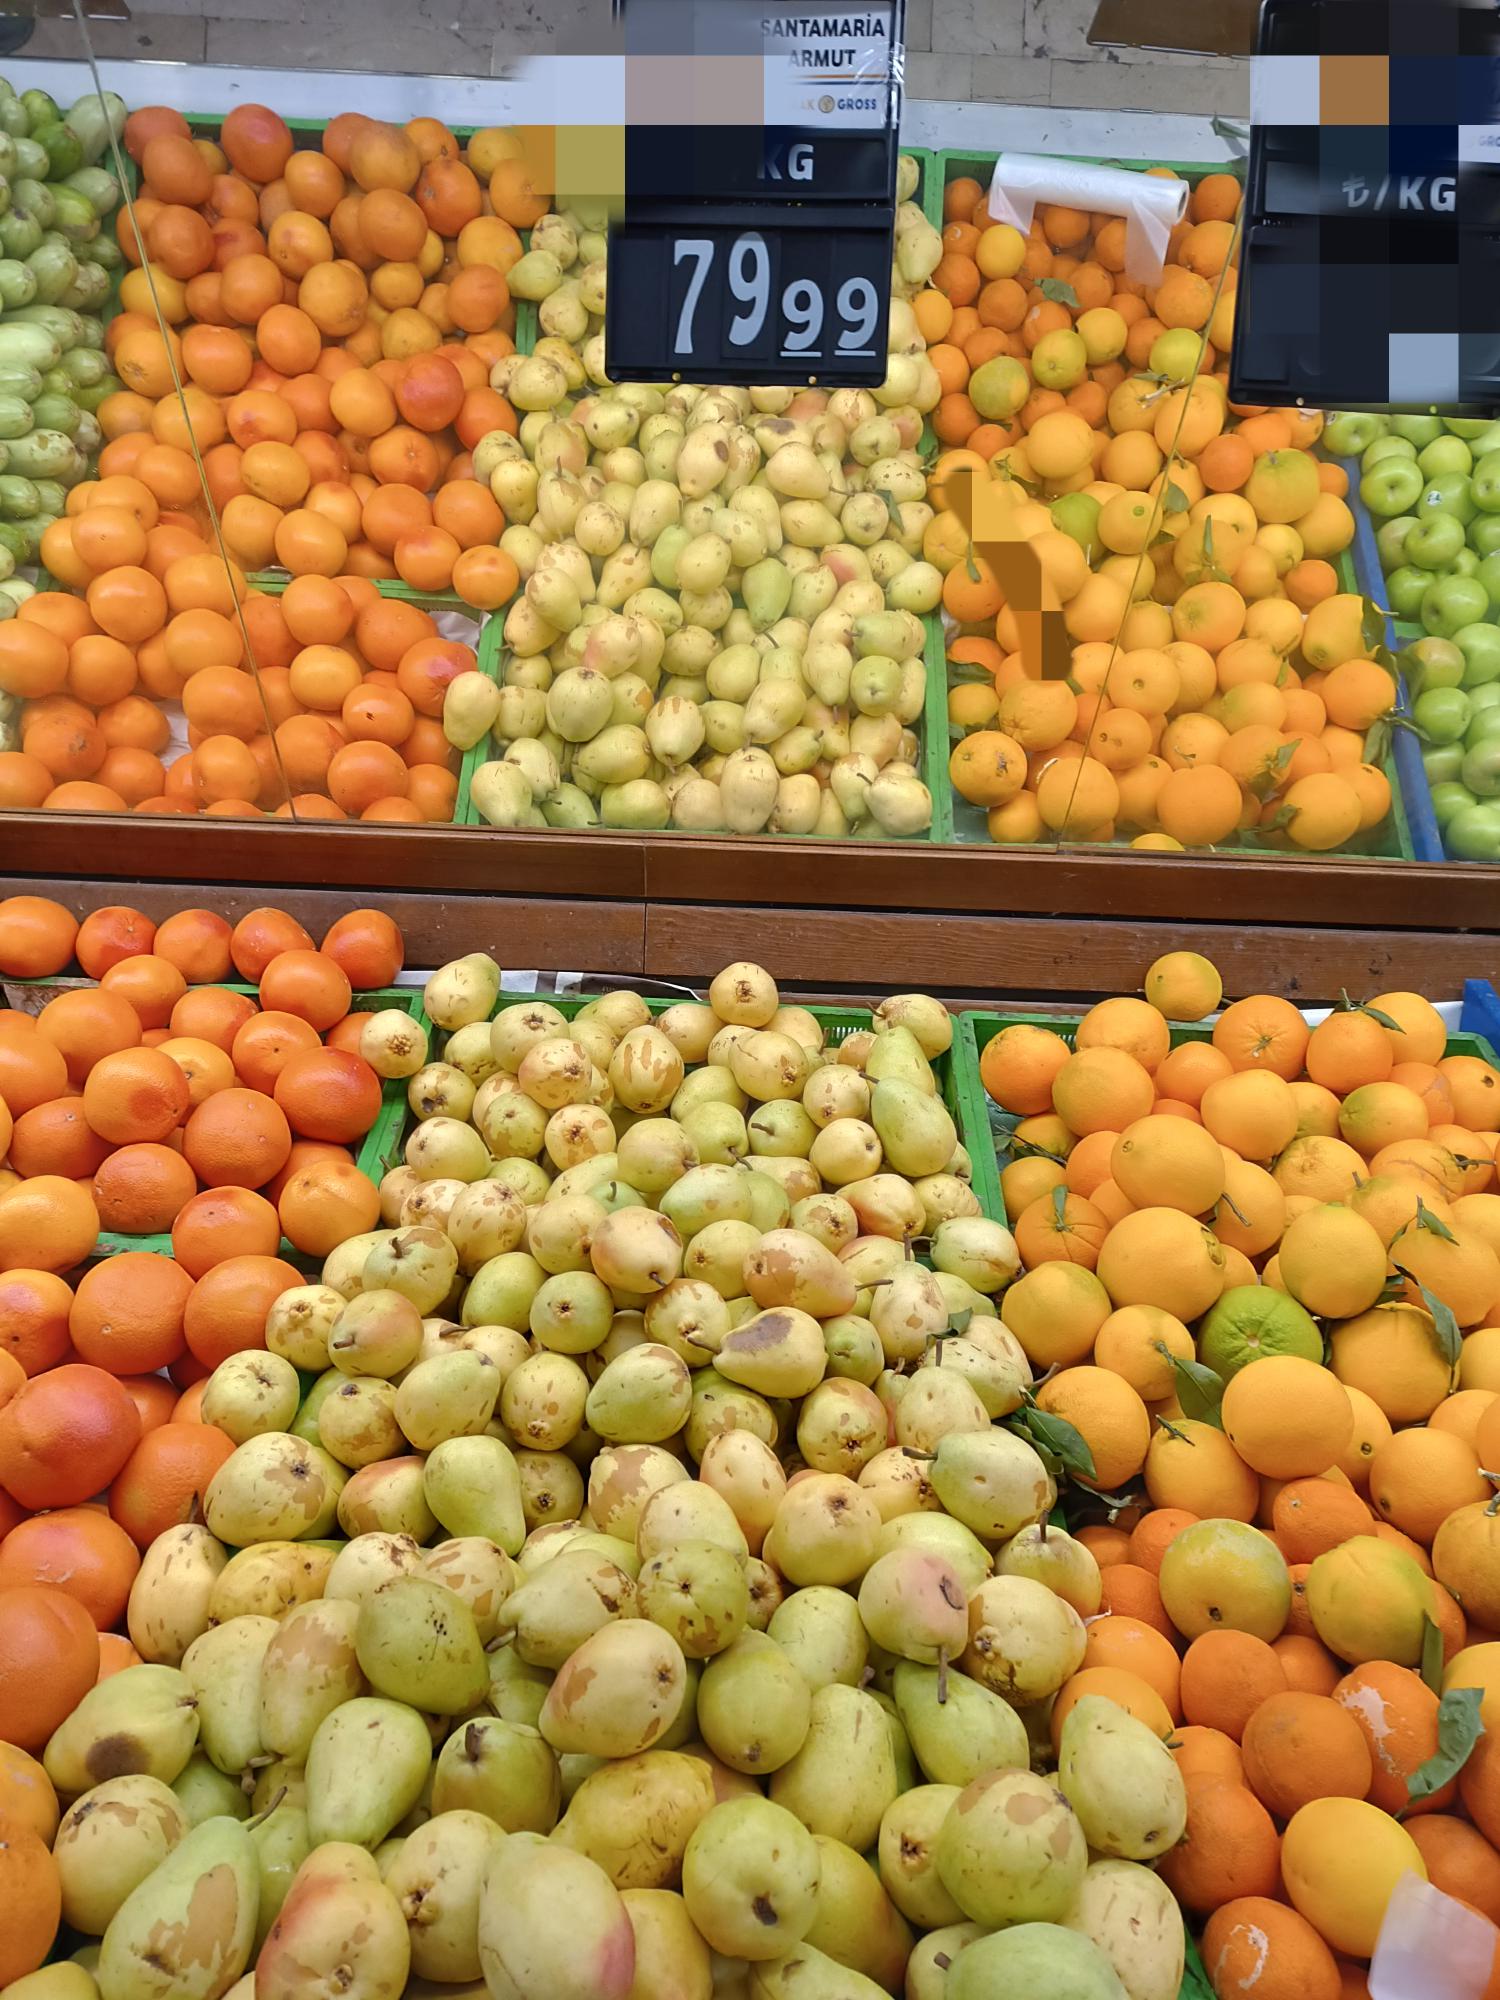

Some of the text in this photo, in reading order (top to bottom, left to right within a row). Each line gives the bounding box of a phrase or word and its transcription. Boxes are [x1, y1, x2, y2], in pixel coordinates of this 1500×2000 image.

[761, 14, 885, 37] SANTAMARİA
[788, 49, 856, 67] ARMUT
[837, 98, 877, 110] GROSS
